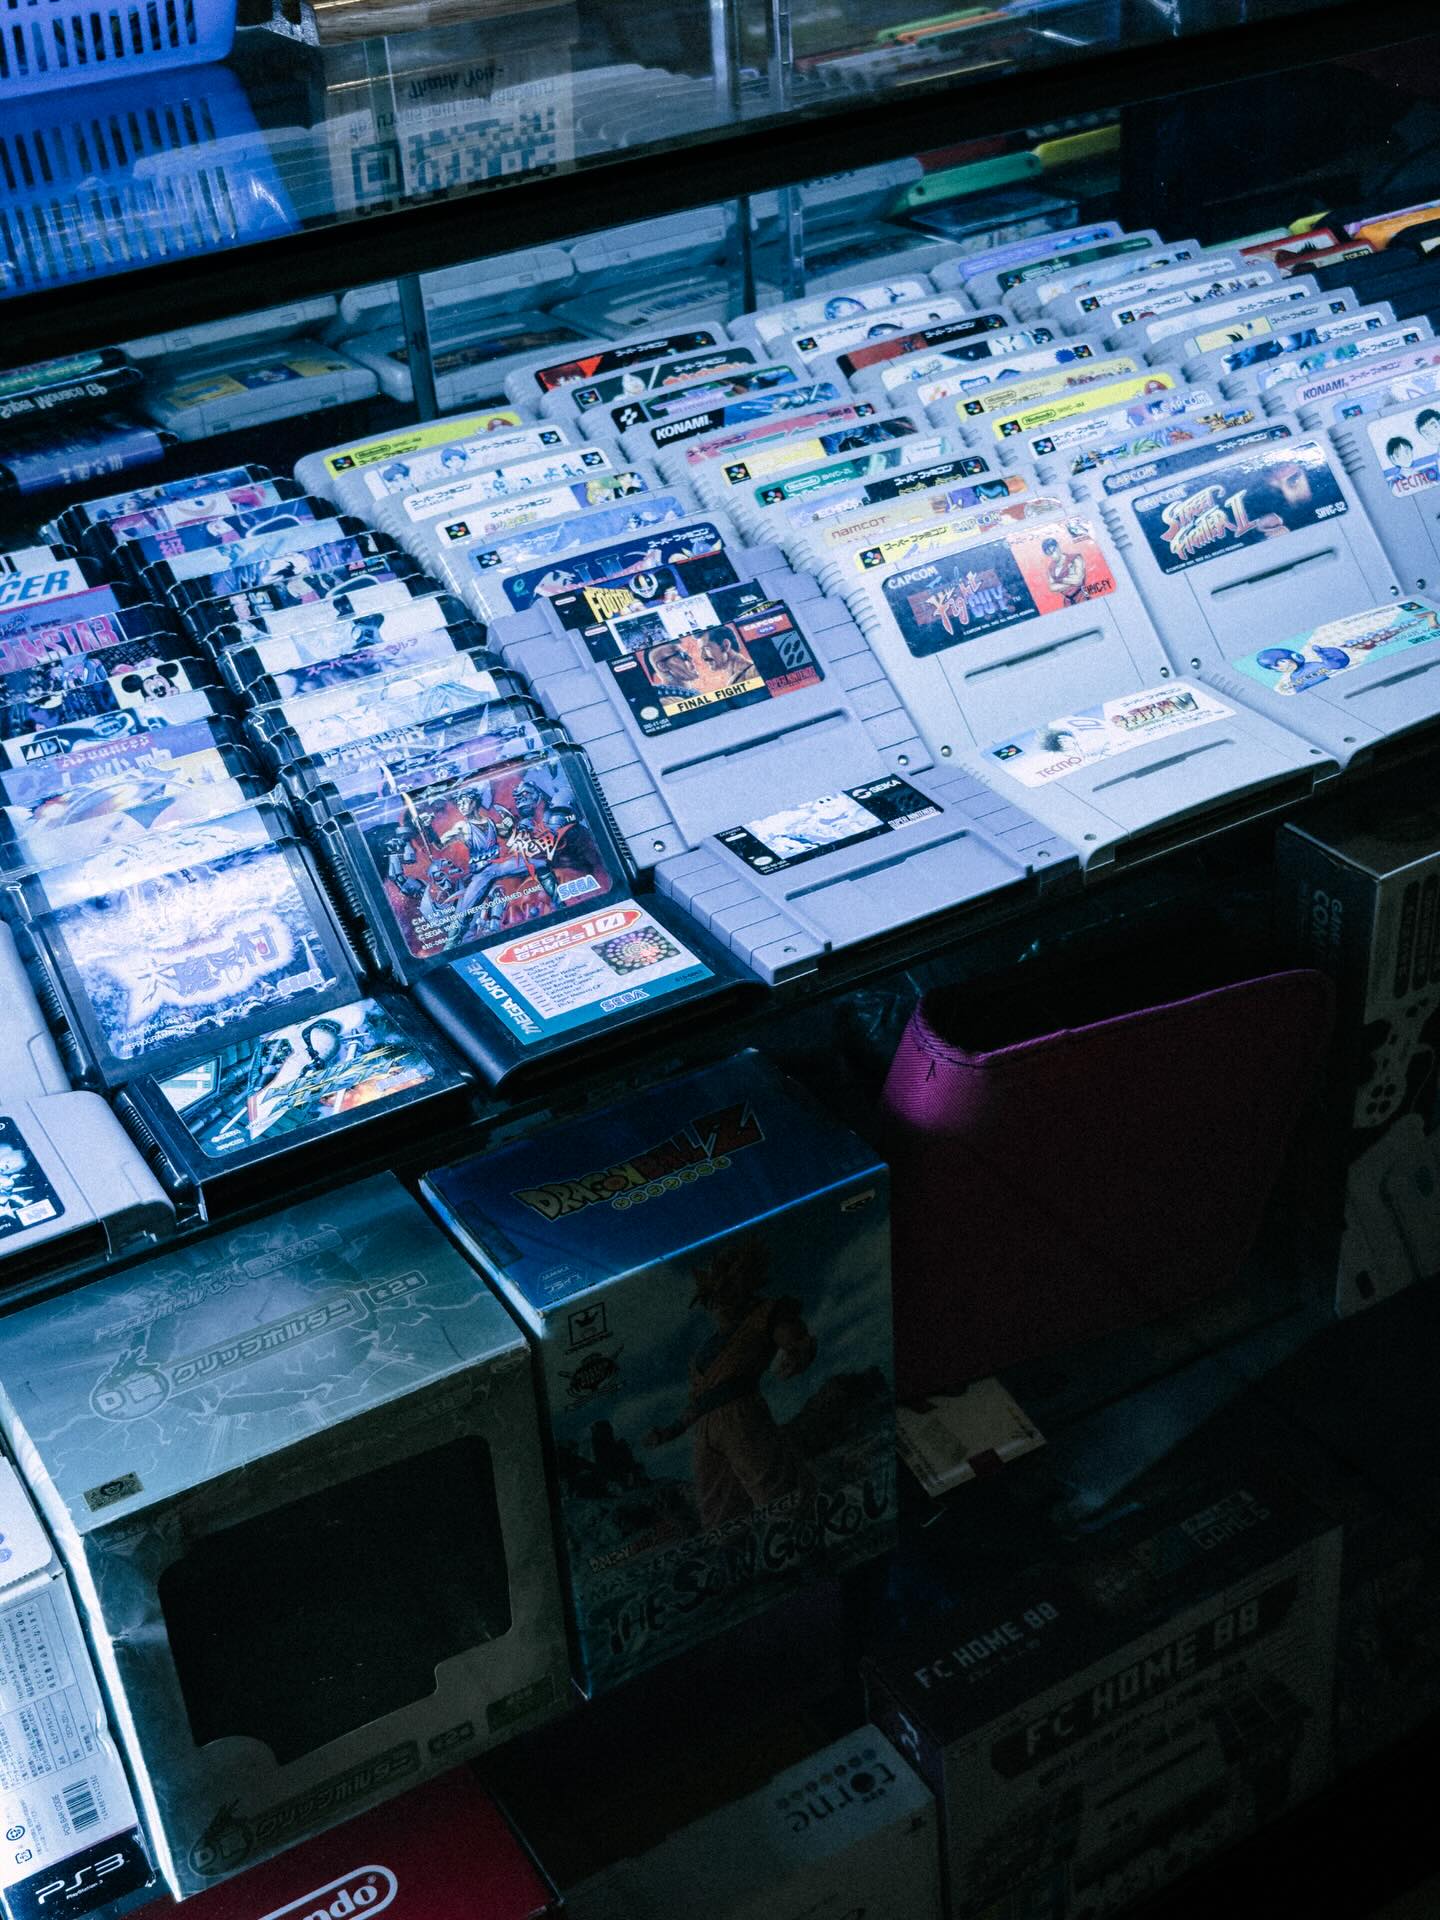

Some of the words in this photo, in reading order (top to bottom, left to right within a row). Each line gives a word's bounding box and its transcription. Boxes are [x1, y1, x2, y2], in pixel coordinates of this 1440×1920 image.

[1303, 378, 1346, 399] KONAMI
[656, 415, 711, 440] KONAMI
[1105, 464, 1157, 489] CAPCOM
[888, 566, 938, 589] CAPCOM
[743, 615, 784, 631] CAPCOM
[677, 695, 712, 712] FINAL
[715, 682, 748, 700] FIGHT
[1036, 756, 1082, 779] TECMO
[869, 779, 902, 793] SEIKA
[558, 874, 601, 900] SEGA
[513, 929, 571, 955] MEGA
[583, 911, 626, 937] 10
[515, 934, 585, 961] GAMES
[466, 957, 506, 998] DRIVE
[601, 988, 650, 1012] SEGA
[501, 996, 542, 1035] MEGA
[514, 1163, 649, 1220] DRAGON
[629, 1129, 706, 1180] BALL
[913, 1659, 953, 1689] FC
[952, 1619, 1024, 1668] HOME
[1026, 1702, 1077, 1758] FC
[1091, 1633, 1199, 1719] HOME
[1213, 1600, 1260, 1650] 88
[35, 1851, 127, 1905] PS3
